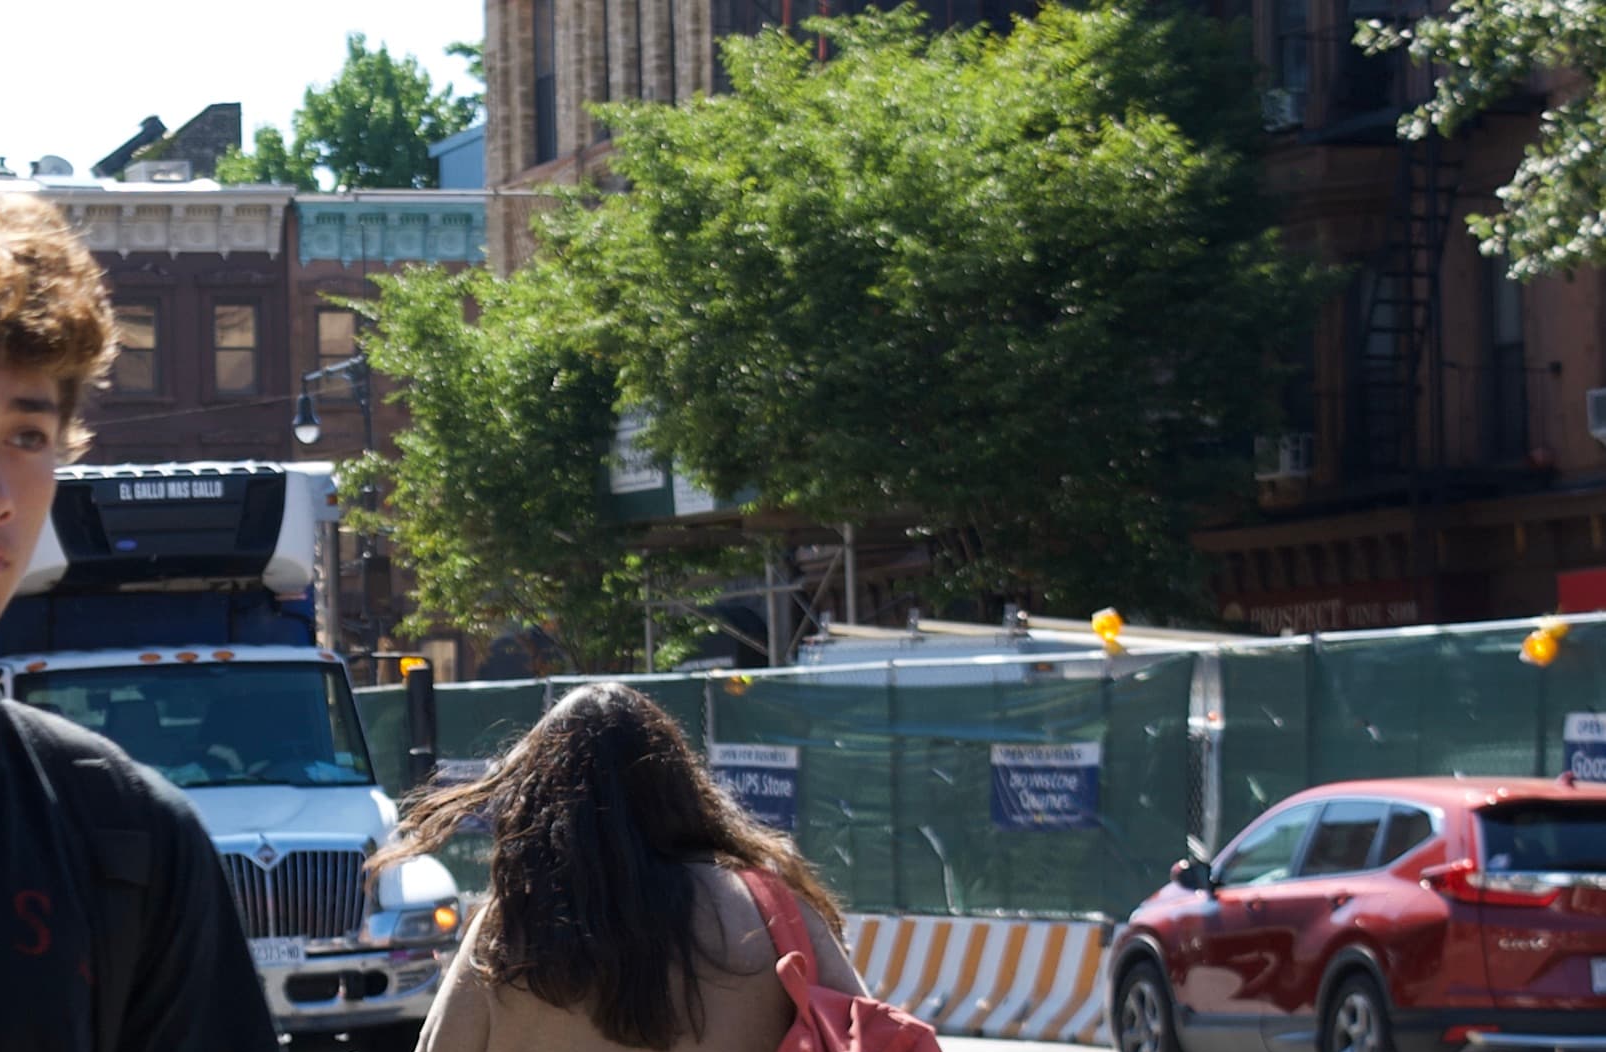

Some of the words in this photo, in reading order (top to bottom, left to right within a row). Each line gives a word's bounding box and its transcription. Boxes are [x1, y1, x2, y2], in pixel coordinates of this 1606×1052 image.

[119, 483, 133, 500] EL
[134, 482, 165, 499] GALLO
[167, 481, 190, 498] MAS
[192, 480, 223, 498] GALLO
[735, 773, 759, 795] UPS
[761, 774, 793, 797] Store
